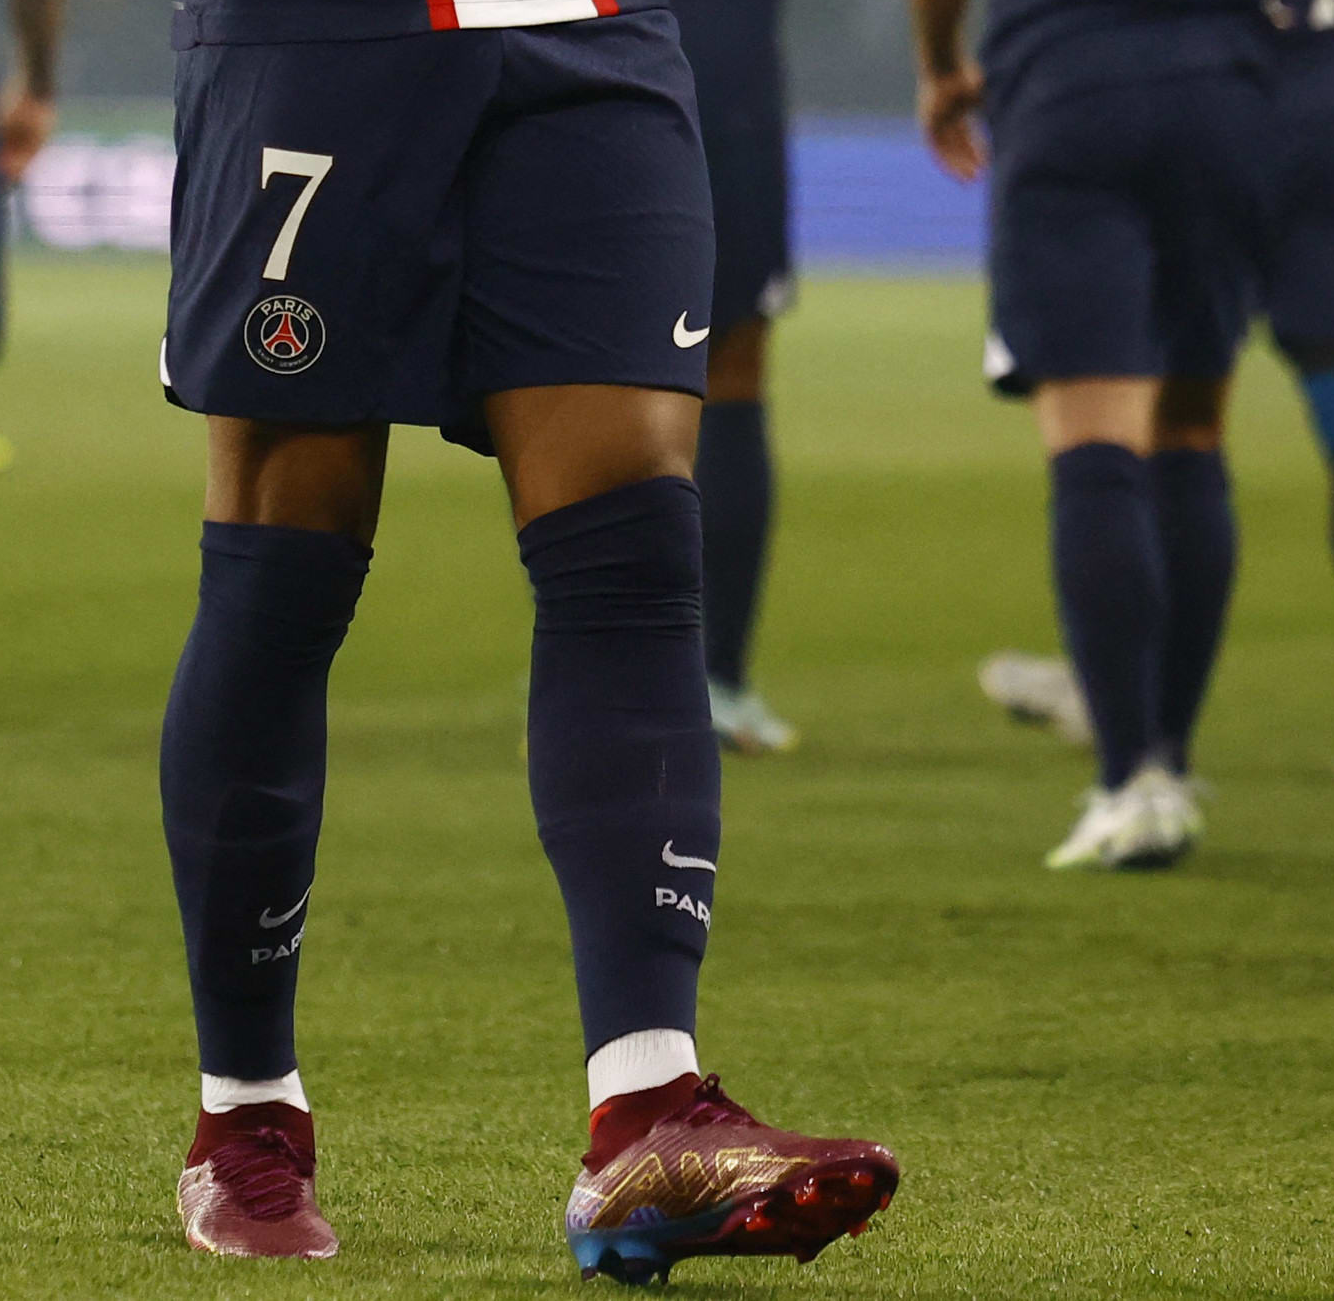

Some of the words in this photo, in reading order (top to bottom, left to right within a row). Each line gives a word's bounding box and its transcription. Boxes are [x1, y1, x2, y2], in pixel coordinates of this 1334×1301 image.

[261, 146, 334, 282] 7
[260, 299, 314, 322] PARIS
[655, 887, 711, 933] PAR
[251, 924, 305, 965] PAR
